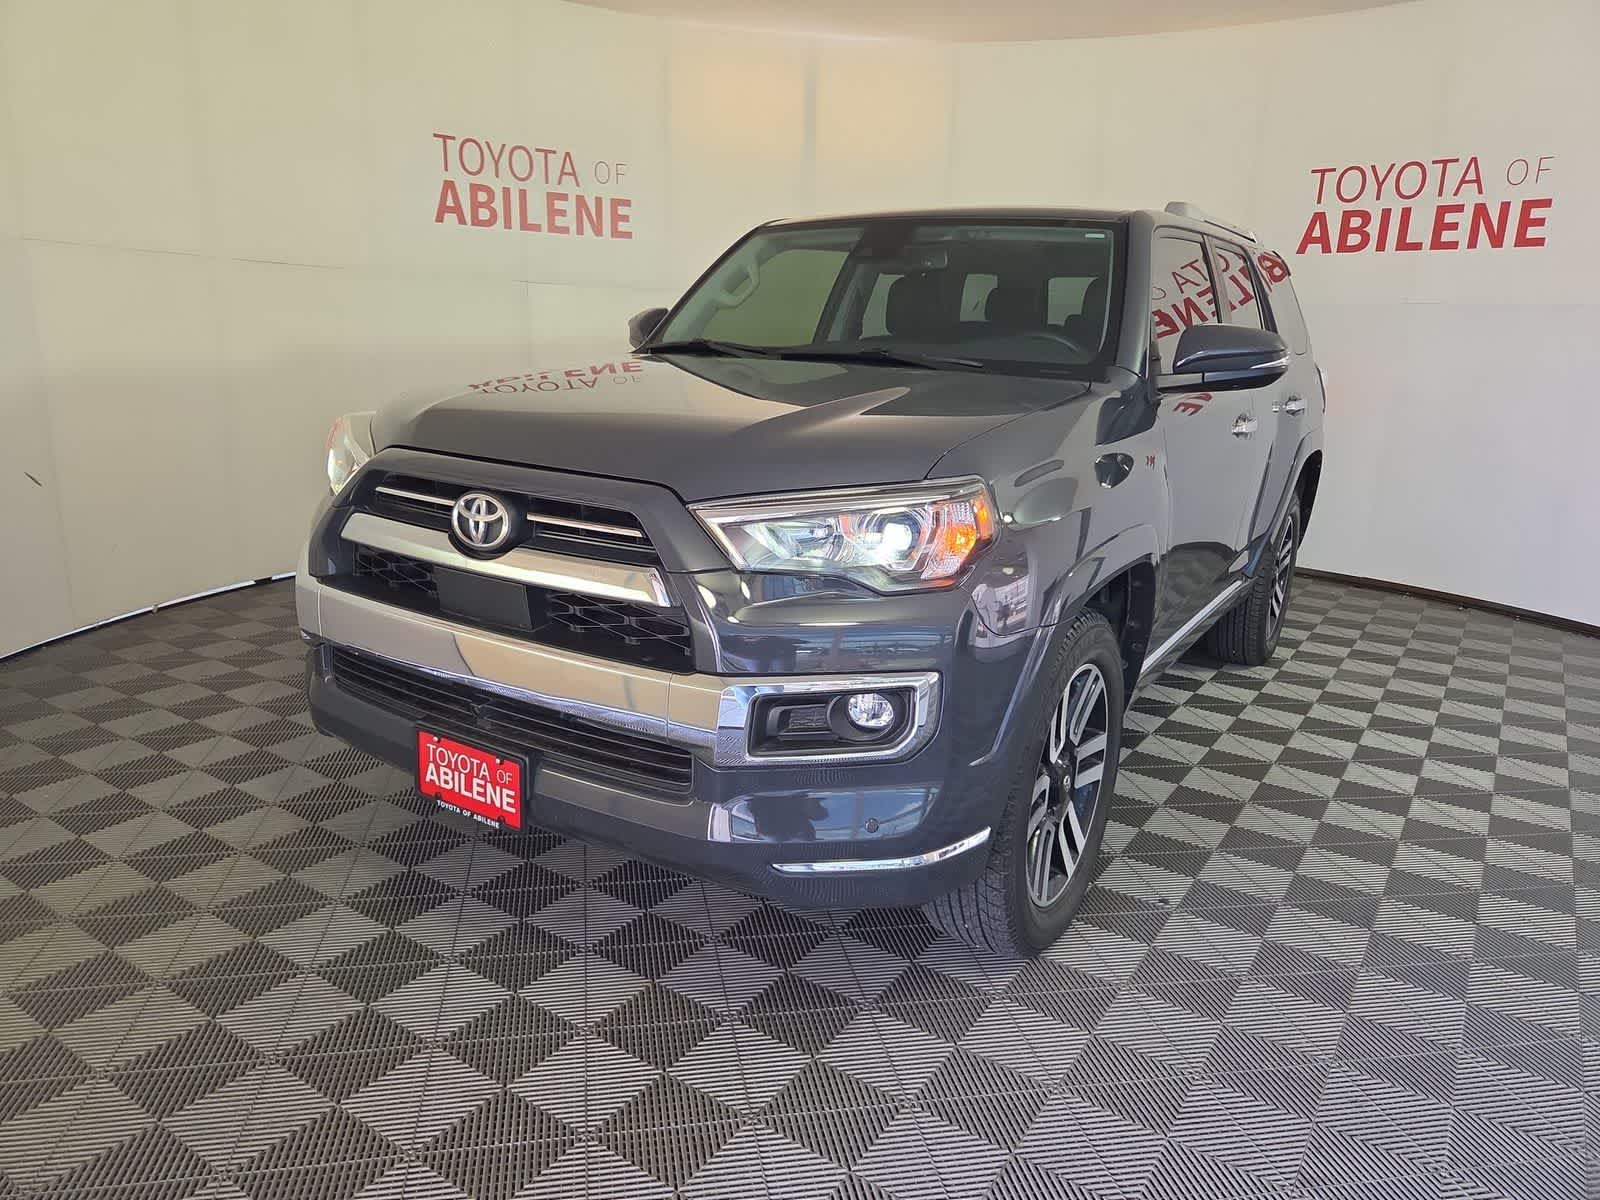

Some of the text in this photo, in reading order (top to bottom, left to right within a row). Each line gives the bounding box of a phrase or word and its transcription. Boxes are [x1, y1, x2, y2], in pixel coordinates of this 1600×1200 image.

[433, 132, 628, 188] TOYOTA OF
[1310, 155, 1556, 205] TOYOTA OF
[434, 179, 633, 240] ABILENE
[1296, 197, 1553, 255] ABILENE
[425, 762, 517, 814] ABILENE
[427, 743, 513, 785] TOYOTA OF
[436, 799, 500, 829] TOYOTA OF ABILENE
